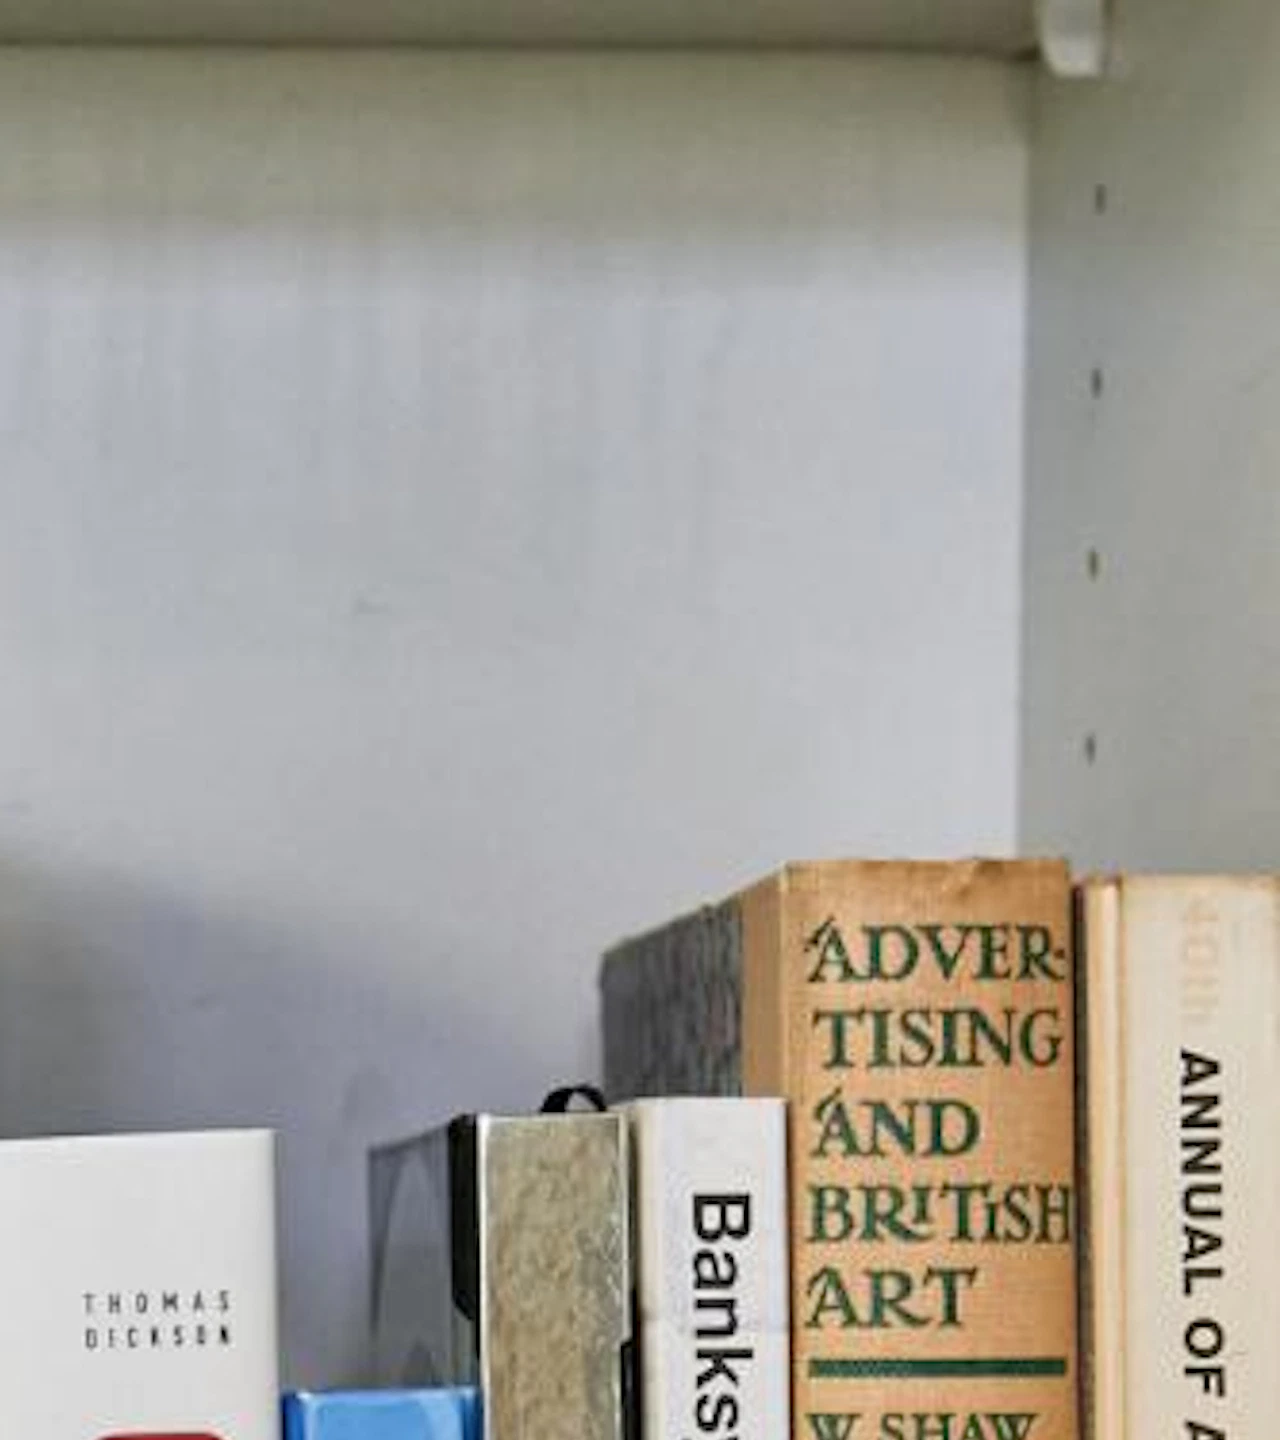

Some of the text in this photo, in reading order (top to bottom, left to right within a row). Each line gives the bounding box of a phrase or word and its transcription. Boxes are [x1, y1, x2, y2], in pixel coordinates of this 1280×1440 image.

[812, 1007, 1063, 1068] TISING
[810, 1089, 981, 1158] AND
[1179, 1048, 1223, 1295] ANNUAL
[806, 1185, 1072, 1243] BRITISH
[84, 1290, 232, 1315] THOMAS
[805, 1266, 980, 1329] ART
[85, 1325, 232, 1350] DICKSON
[1183, 1318, 1226, 1398] OF
